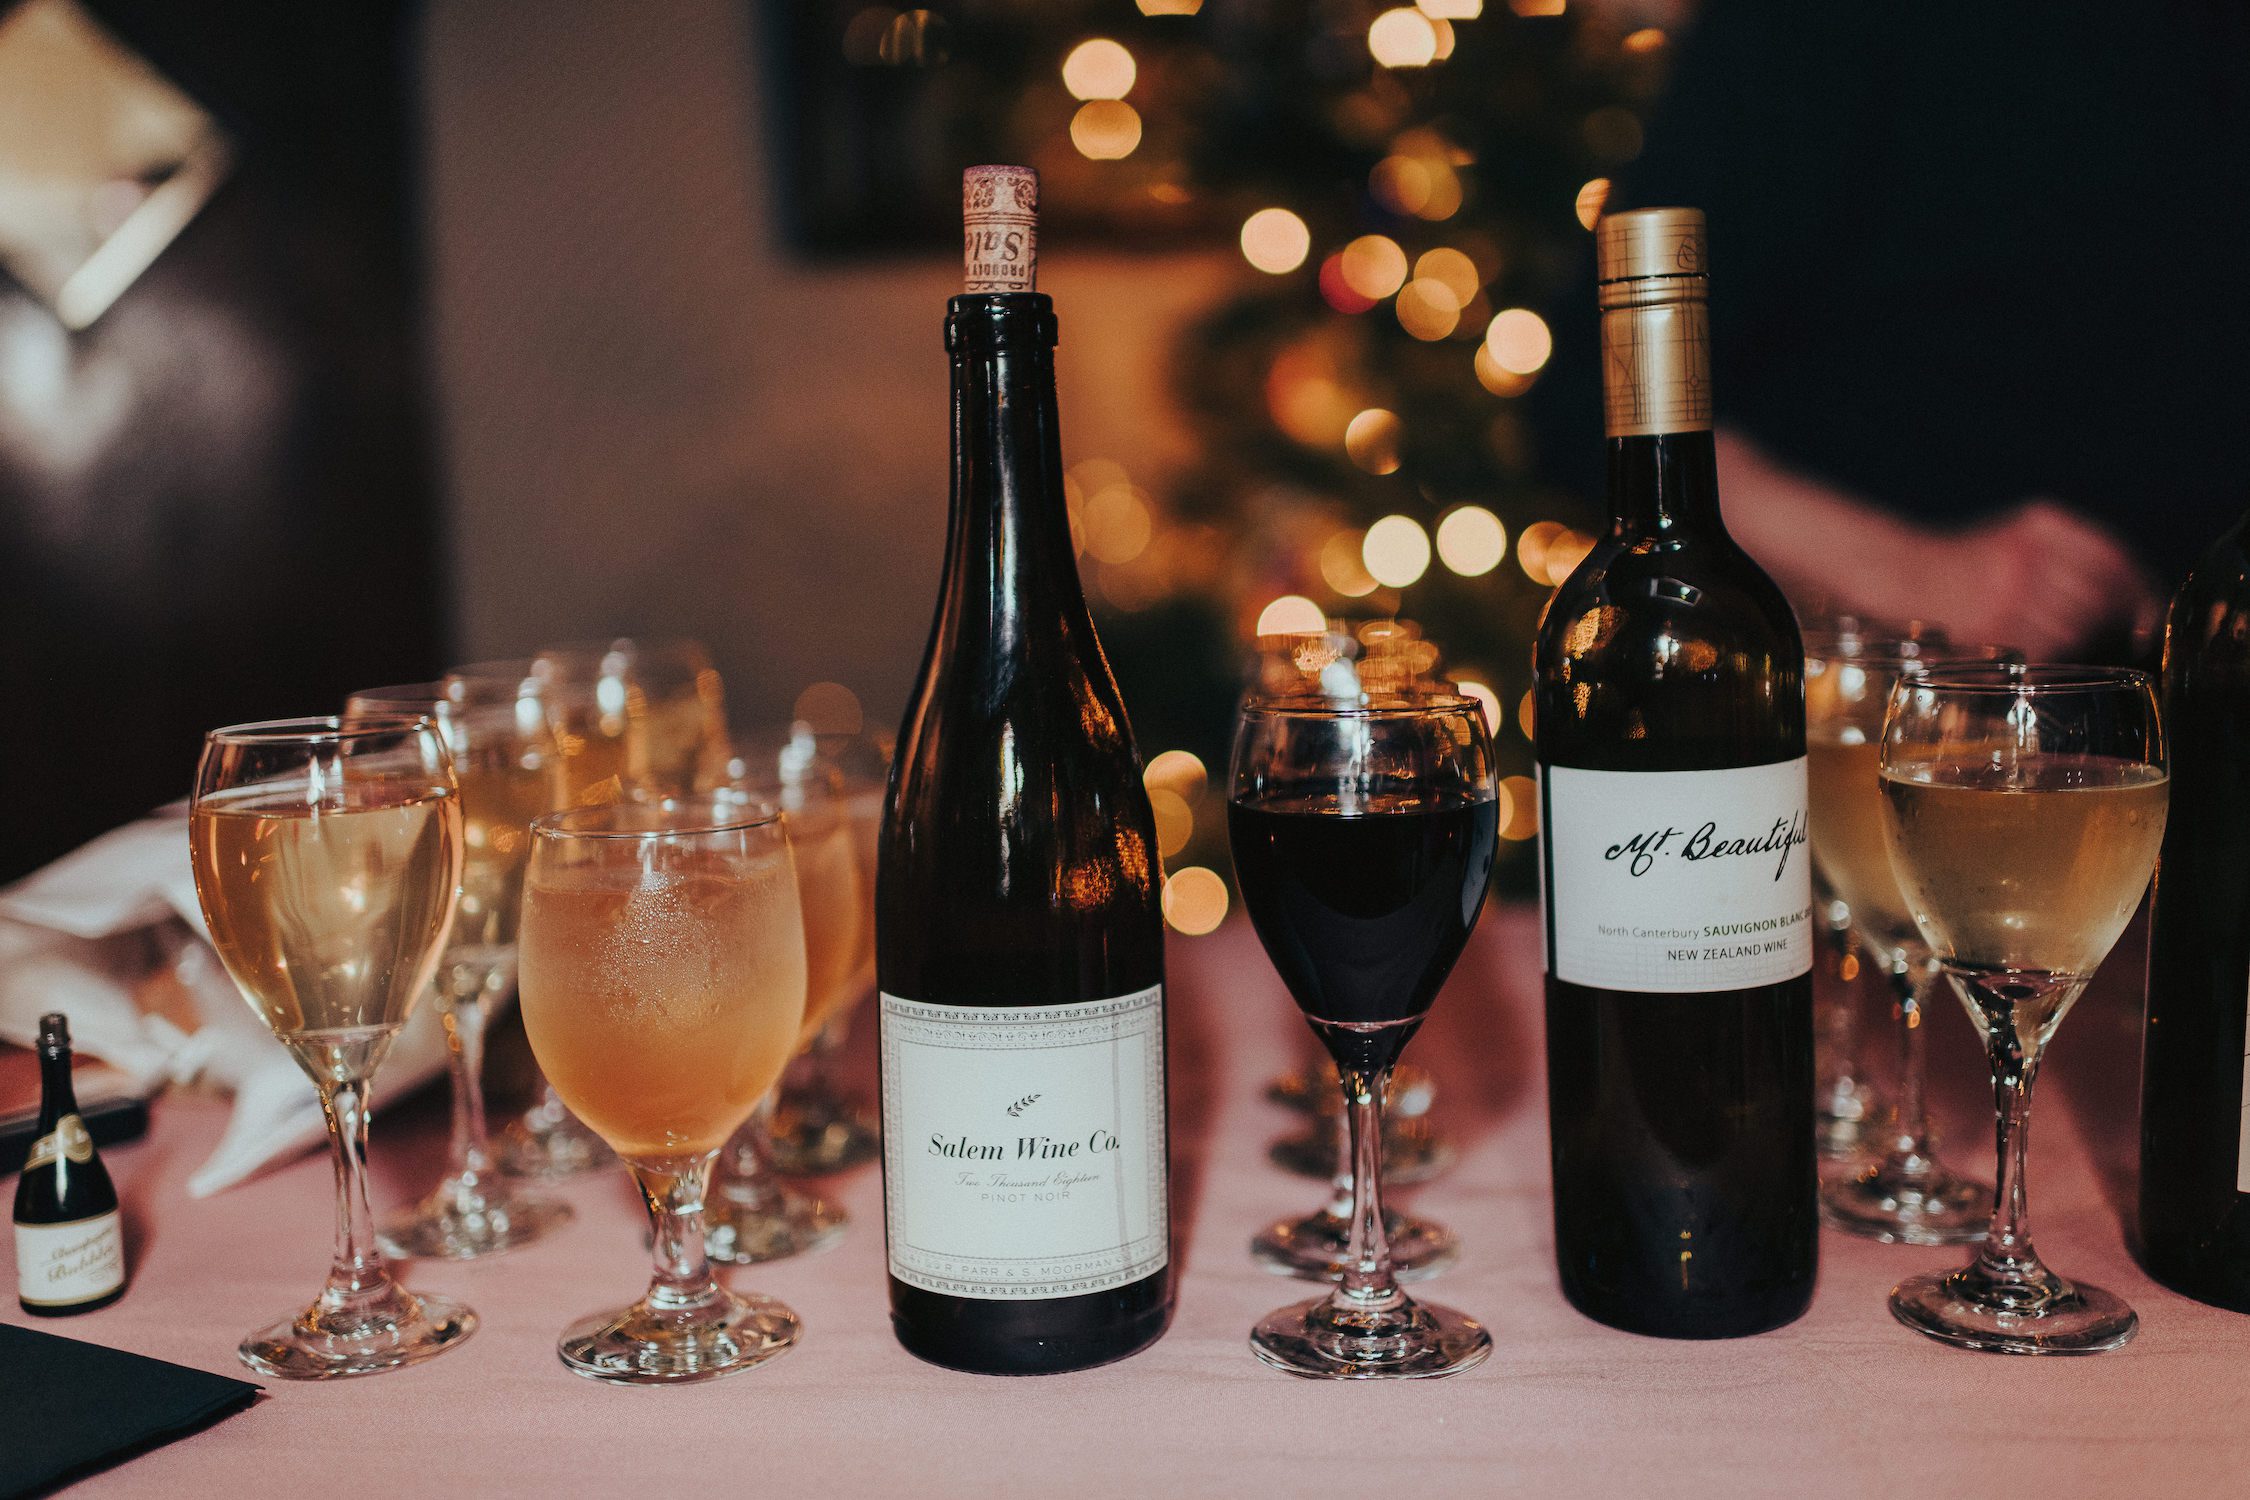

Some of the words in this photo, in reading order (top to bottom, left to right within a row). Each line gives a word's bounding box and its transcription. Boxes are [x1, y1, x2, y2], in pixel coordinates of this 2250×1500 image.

[1604, 827, 1684, 877] Mt.
[1681, 809, 1808, 882] Beautiful
[1598, 924, 1629, 938] North
[1632, 926, 1700, 940] Canterbury
[1703, 919, 1778, 938] SAUVIGNON
[1780, 911, 1804, 927] BLANC
[1667, 950, 1699, 961] NEW
[1703, 943, 1761, 960] ZEALAND
[1764, 938, 1789, 953] WINE
[928, 1133, 1003, 1160] Salem
[1017, 1136, 1080, 1160] Wine
[1089, 1129, 1121, 1154] Co.
[954, 1171, 981, 1187] Two
[987, 1173, 1050, 1188] Thousand
[1053, 1170, 1100, 1190] Eighteen
[981, 1193, 1027, 1203] PINOT
[1034, 1191, 1071, 1202] NOIR
[962, 1265, 999, 1276] PARR
[1006, 1268, 1014, 1277] &
[1041, 1258, 1112, 1275] MOORMAN
